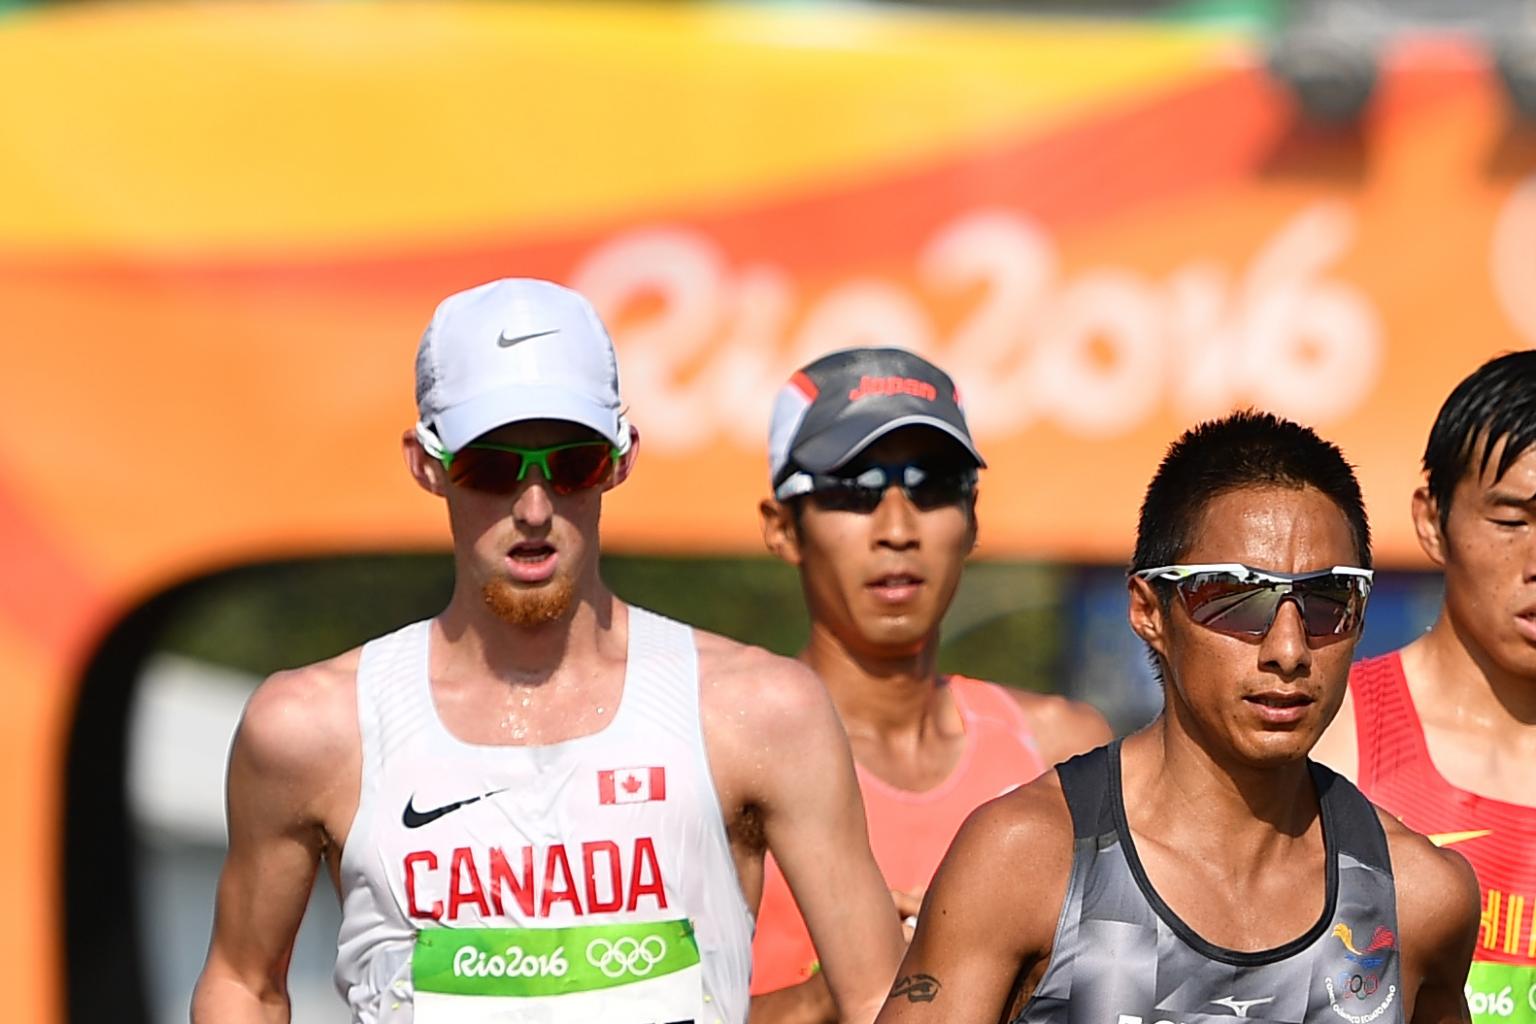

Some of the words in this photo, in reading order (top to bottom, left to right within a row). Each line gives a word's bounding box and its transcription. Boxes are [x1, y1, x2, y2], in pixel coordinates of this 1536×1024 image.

[849, 376, 937, 402] Japan
[403, 837, 668, 921] CANADA
[452, 944, 569, 979] Rio2016
